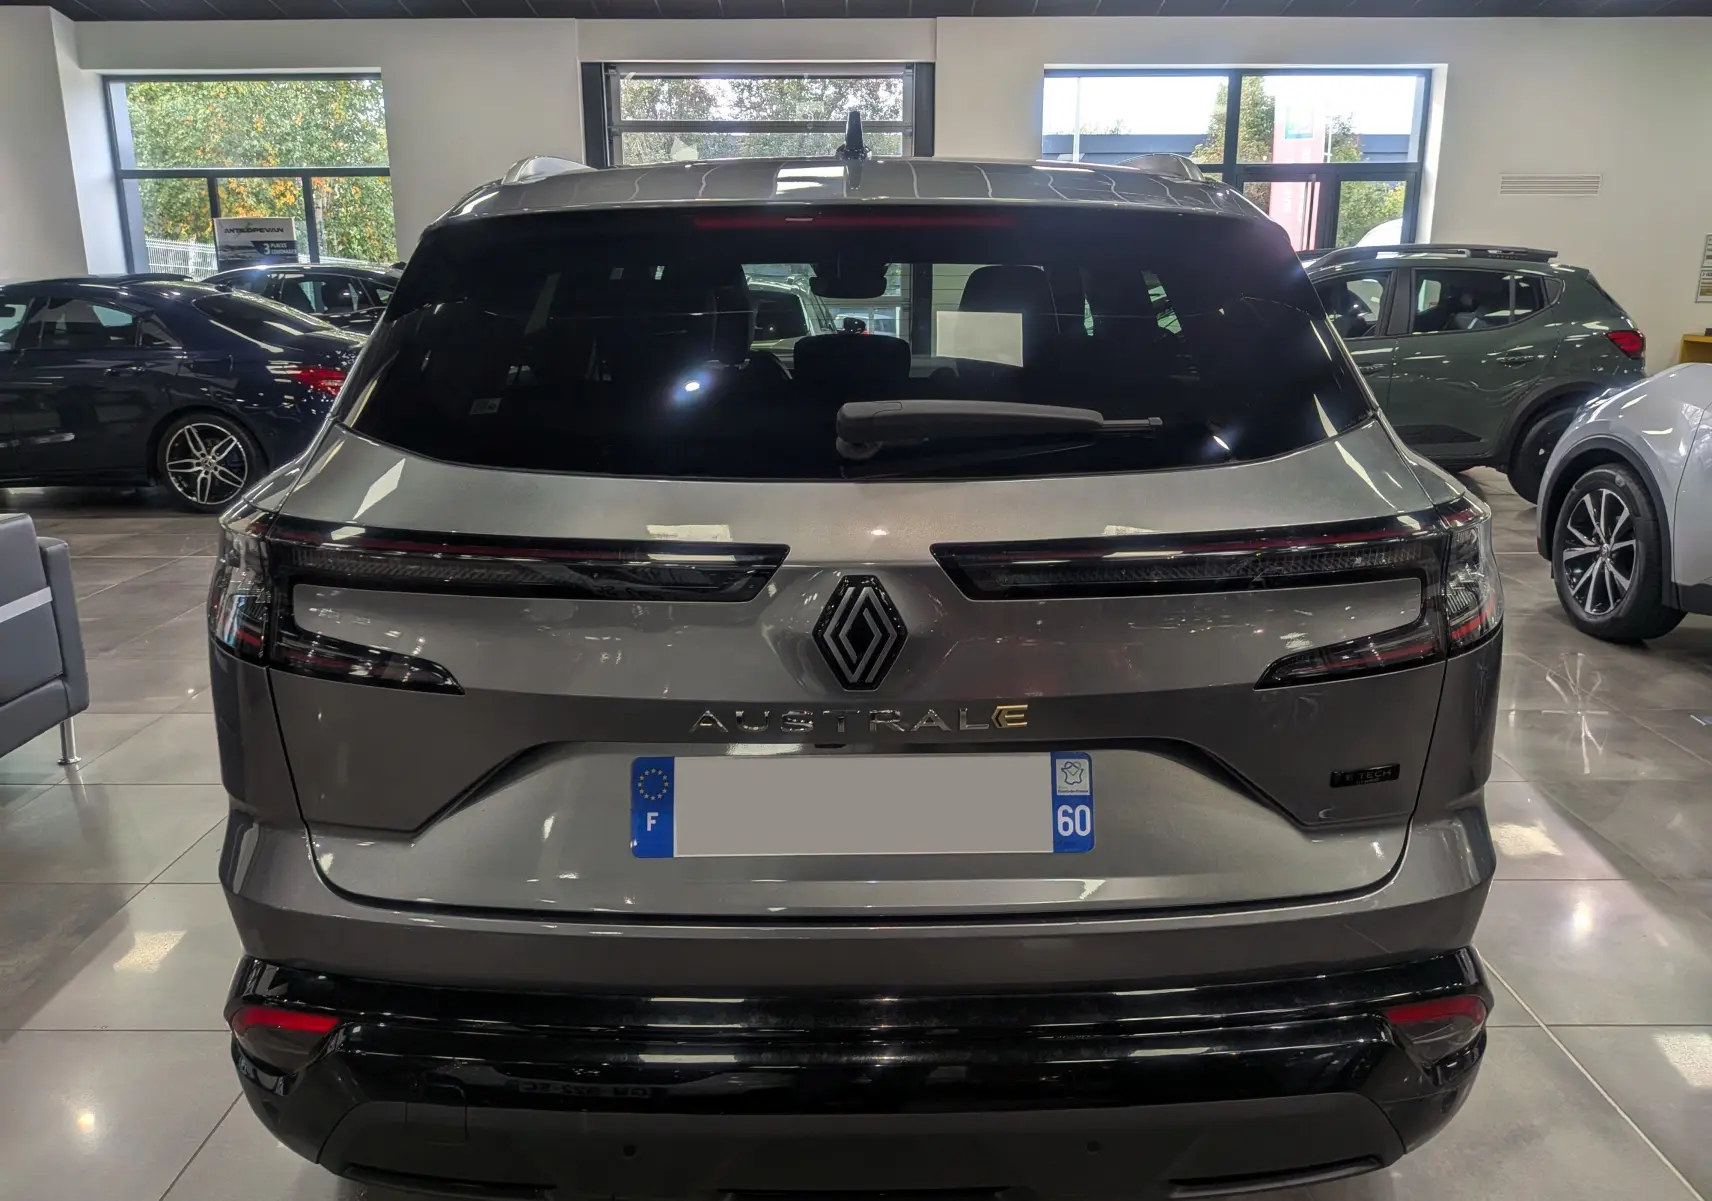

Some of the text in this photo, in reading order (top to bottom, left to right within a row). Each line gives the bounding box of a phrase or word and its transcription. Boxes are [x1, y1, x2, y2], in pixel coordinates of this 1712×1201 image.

[263, 243, 271, 255] 3
[646, 811, 659, 832] F
[1057, 804, 1091, 837] 60
